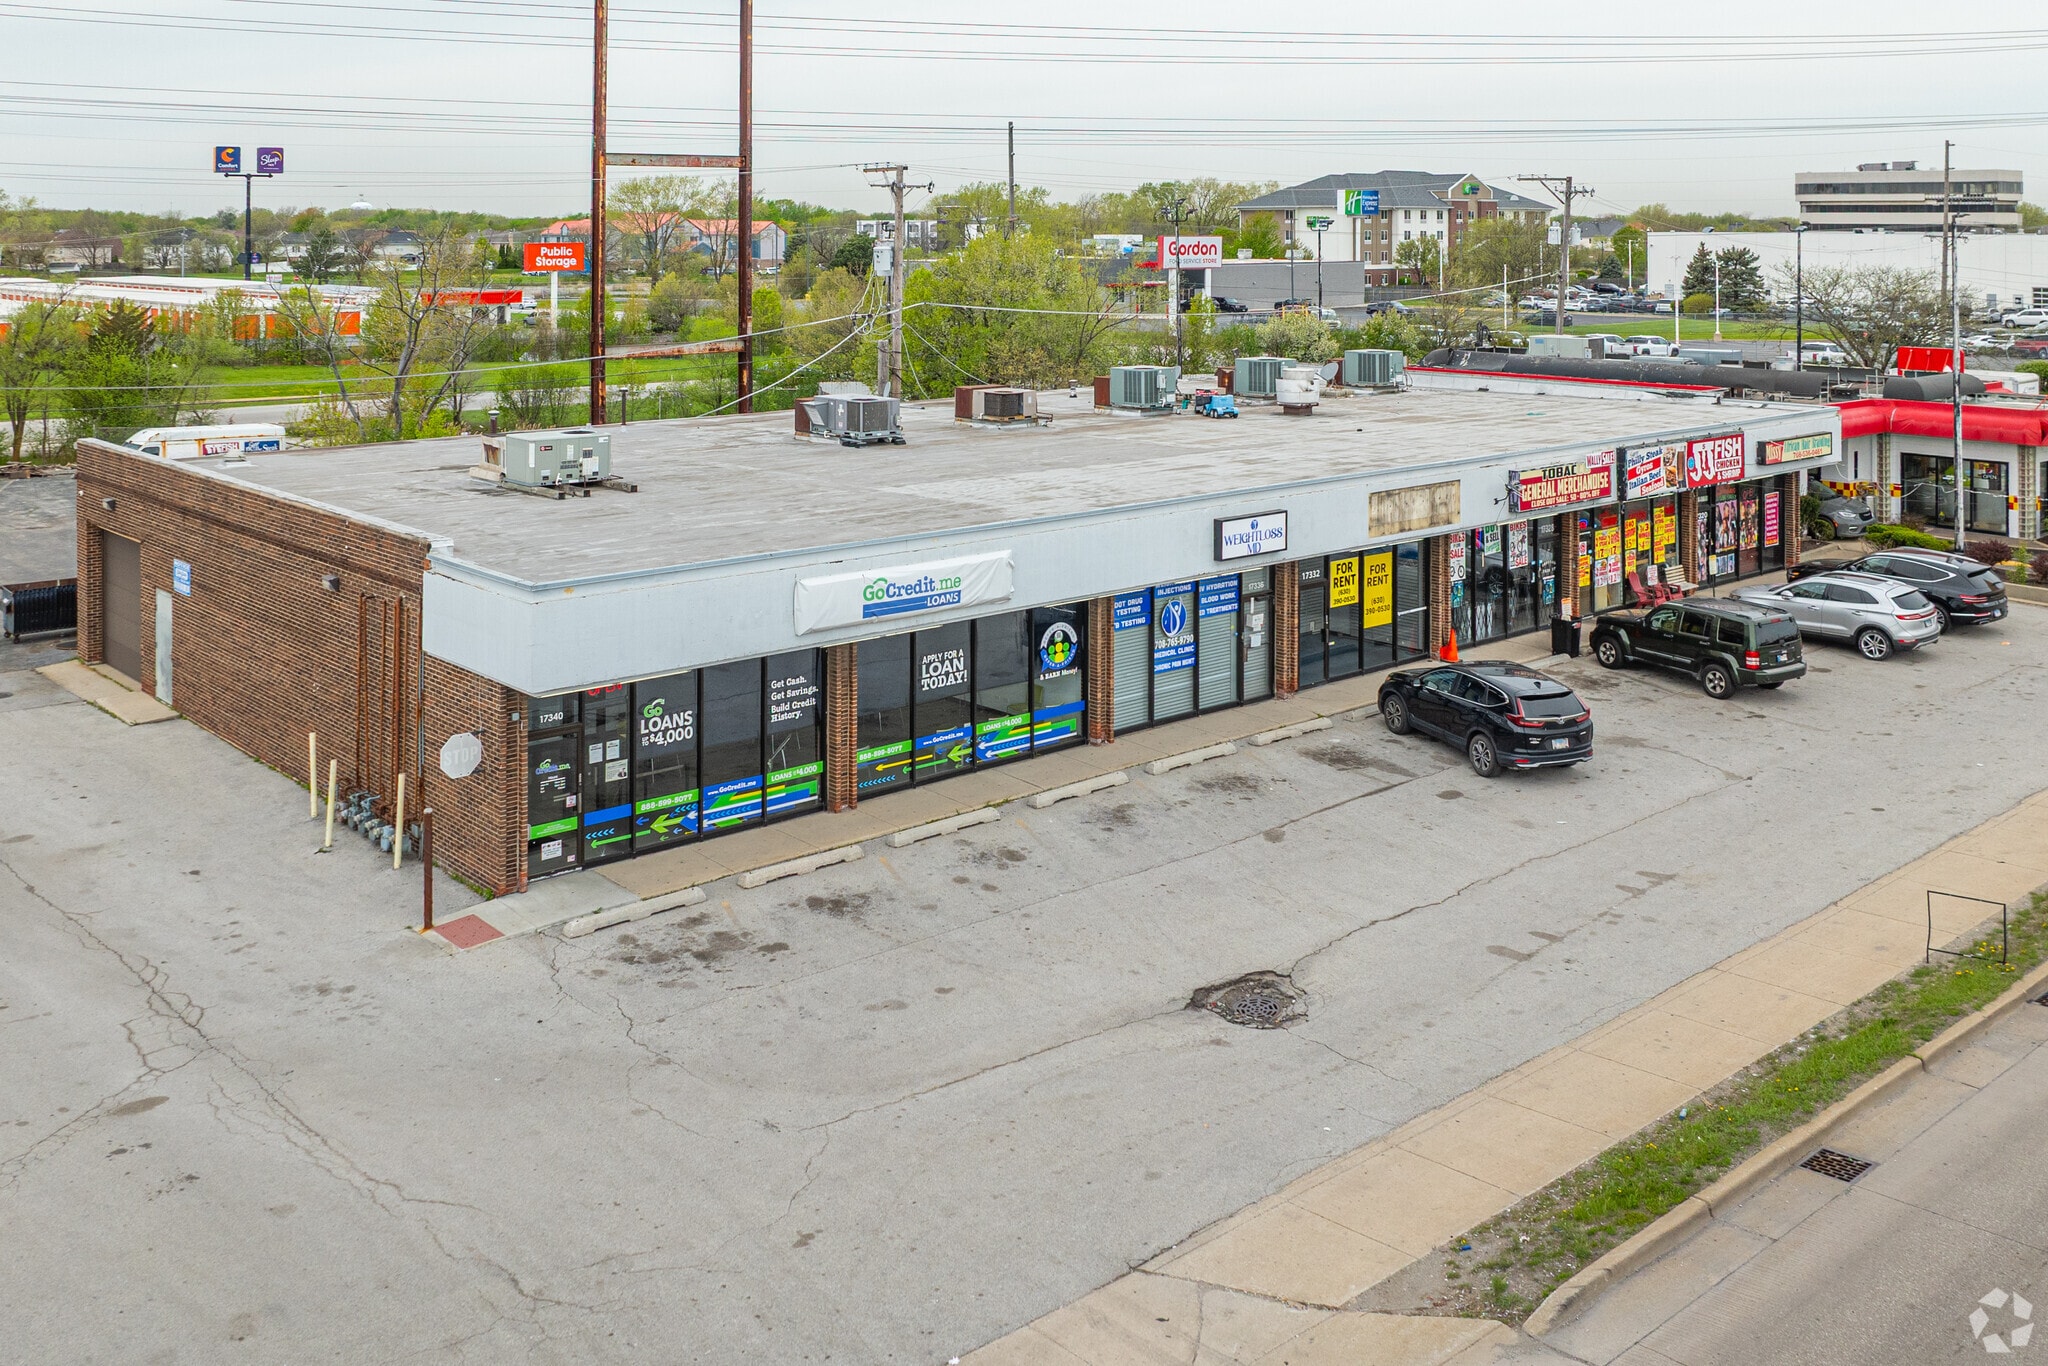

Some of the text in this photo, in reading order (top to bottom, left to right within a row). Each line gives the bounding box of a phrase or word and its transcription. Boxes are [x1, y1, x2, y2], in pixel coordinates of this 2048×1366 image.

[541, 247, 572, 256] Public
[1168, 241, 1217, 256] Gordon
[536, 257, 577, 268] Storage
[1714, 437, 1742, 459] FISH
[1628, 455, 1644, 467] Philly
[1645, 448, 1663, 458] Steak
[1716, 458, 1740, 470] CHICKEN
[1636, 462, 1653, 475] Gyros
[1629, 470, 1661, 490] Italian Beef
[1522, 472, 1608, 502] GENERAL MERCHANDISE
[1641, 479, 1664, 495] Seafood
[1510, 522, 1527, 532] BIKES
[1224, 527, 1283, 546] WEIGHTLOSS
[1490, 532, 1499, 541] SELL
[1247, 542, 1262, 555] MD
[1450, 548, 1464, 559] SALE
[1515, 556, 1528, 566] SALE
[1302, 570, 1320, 580] 17332
[1336, 562, 1353, 575] FOR
[1370, 563, 1386, 575] FOR
[1206, 580, 1238, 590] HYDRATION
[1334, 574, 1356, 589] RENT
[1367, 574, 1389, 587] RENT
[862, 576, 962, 602] GoCredit.me
[1158, 584, 1191, 595] INJECTIONS
[927, 592, 959, 607] LOANS
[1115, 597, 1143, 608] DOT DRUG
[1201, 595, 1218, 604] BLOOD
[1371, 596, 1385, 606] (630)
[1117, 606, 1141, 616] TESTING
[1207, 603, 1238, 614] TREATMENTS
[1365, 604, 1390, 615] 390-0530
[1122, 617, 1145, 627] TESTING
[922, 649, 964, 664] APPLY FOR A
[1154, 645, 1194, 658] MEDICAL CLINIC
[922, 657, 964, 678] LOAN
[771, 676, 807, 689] Get Cash.
[922, 670, 967, 690] TODAY!
[771, 685, 819, 701] Get Savings.
[644, 704, 663, 718] Go
[771, 697, 816, 713] Build Credit
[540, 712, 564, 723] 17340
[641, 710, 693, 734] LOANS
[771, 710, 803, 722] History.
[983, 723, 1001, 732] LOANS
[650, 726, 693, 746] $4,000
[771, 771, 792, 782] LOANS
[708, 780, 756, 796] www.GoCredit.me
